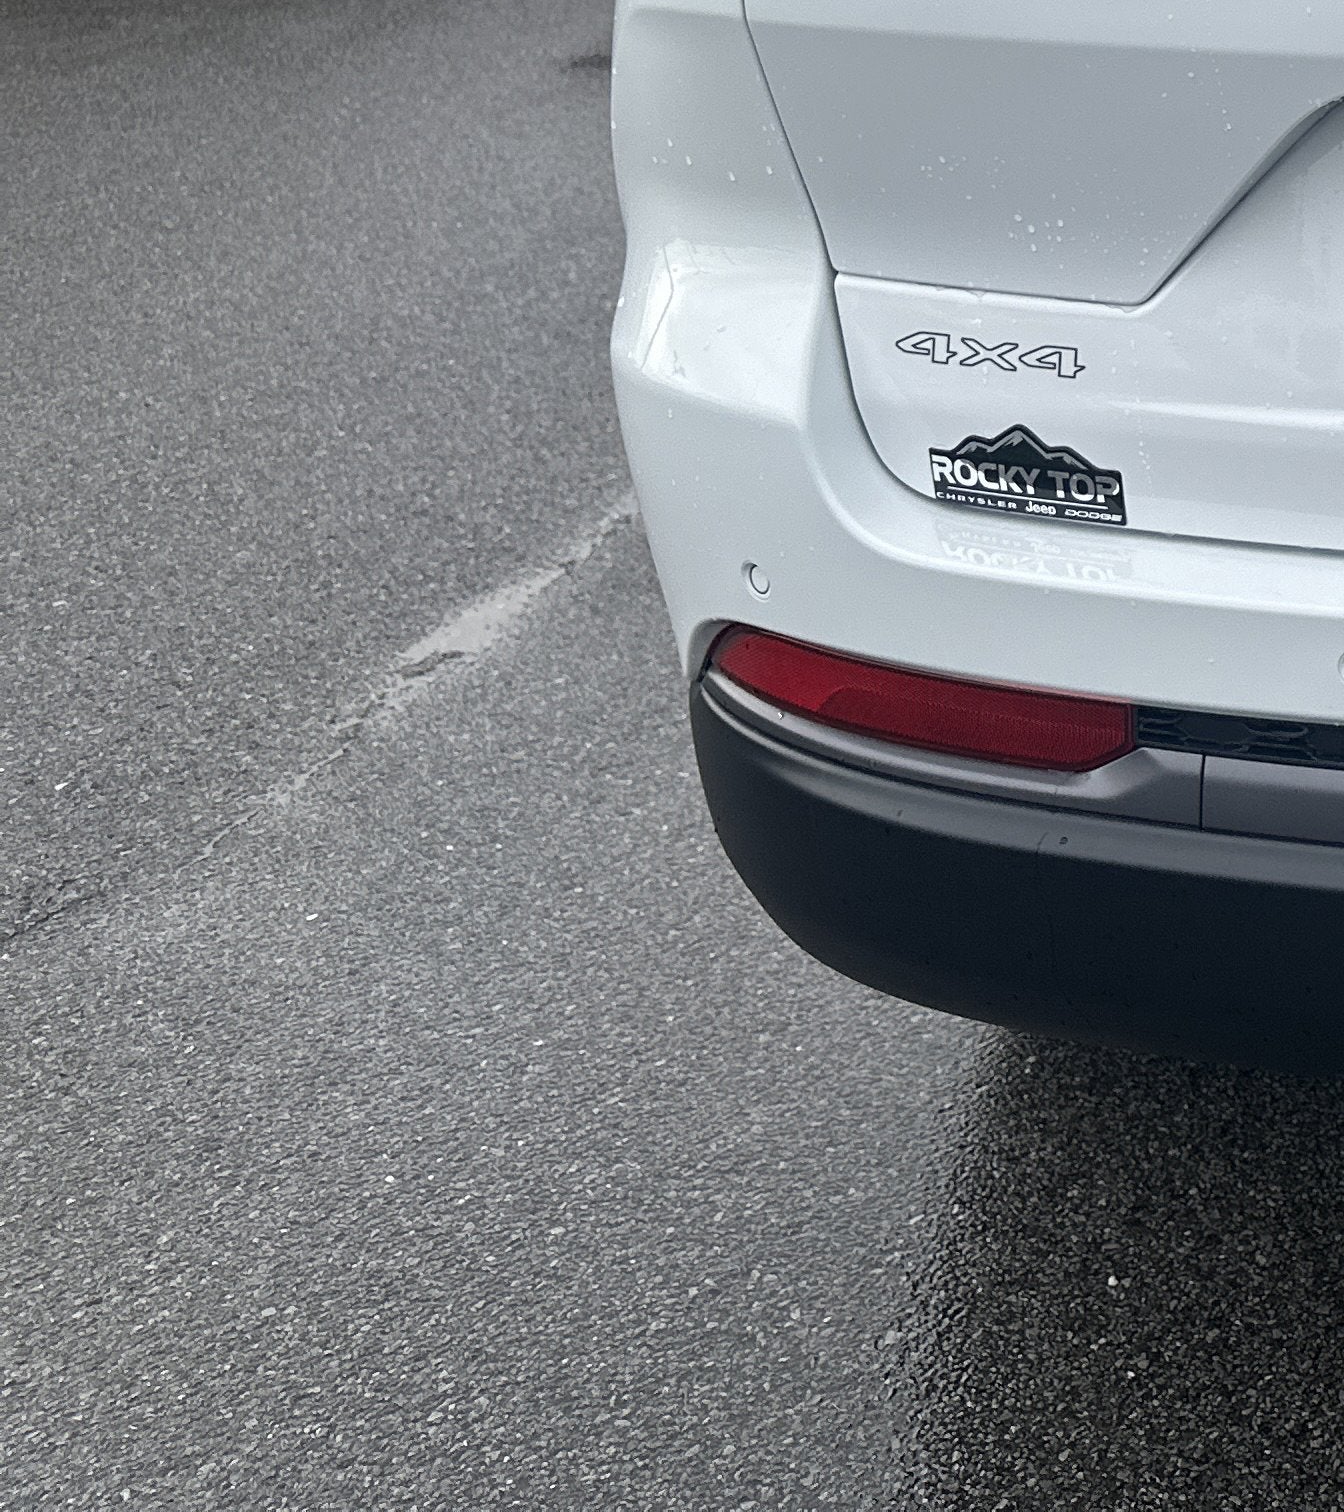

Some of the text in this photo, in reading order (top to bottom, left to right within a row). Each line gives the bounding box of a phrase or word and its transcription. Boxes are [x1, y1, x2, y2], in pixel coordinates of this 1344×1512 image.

[931, 454, 1120, 503] ROCKY TOP
[936, 491, 1122, 522] CHRYSLER Jeep DODGE
